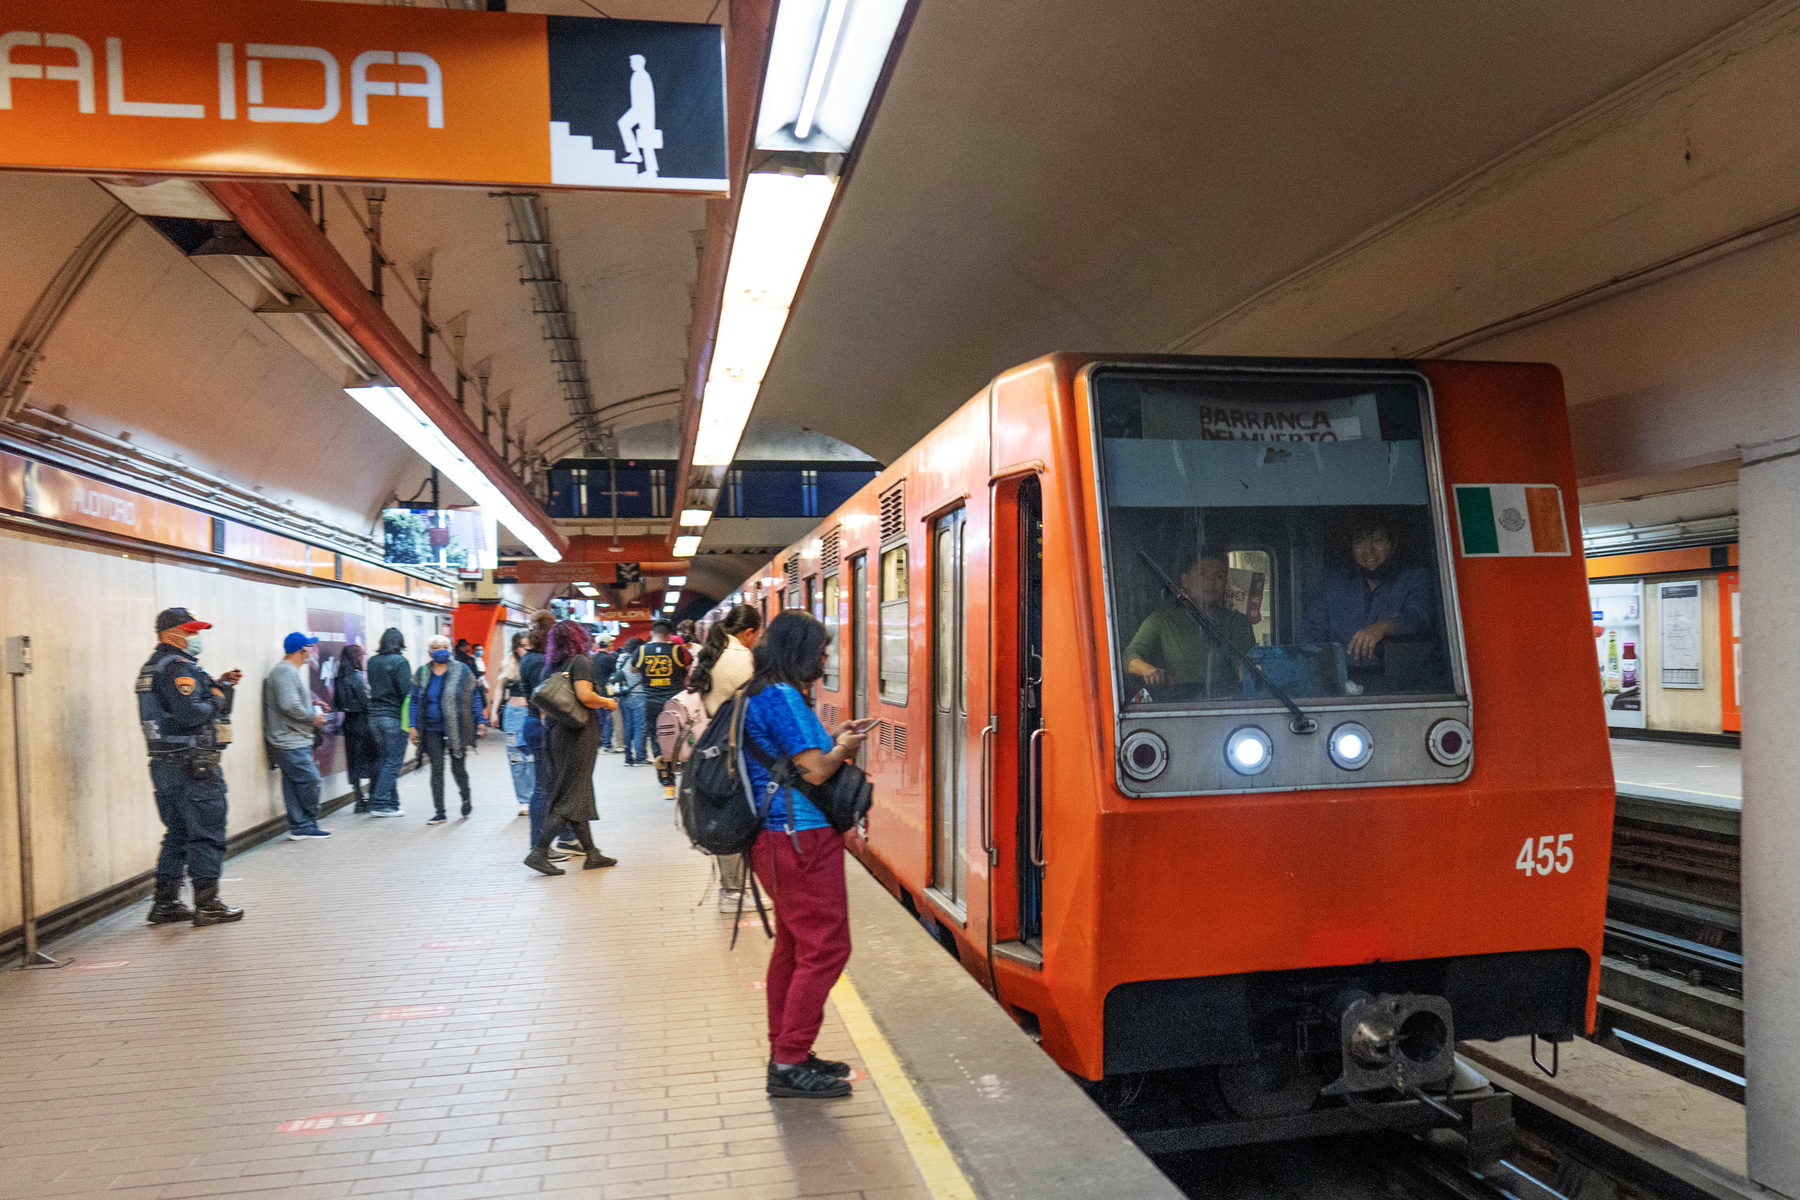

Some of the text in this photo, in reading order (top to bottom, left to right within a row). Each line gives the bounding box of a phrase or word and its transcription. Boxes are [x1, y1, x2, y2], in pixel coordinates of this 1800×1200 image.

[1200, 404, 1332, 430] BARRANCA
[644, 655, 673, 677] 23
[1516, 833, 1574, 877] 455
